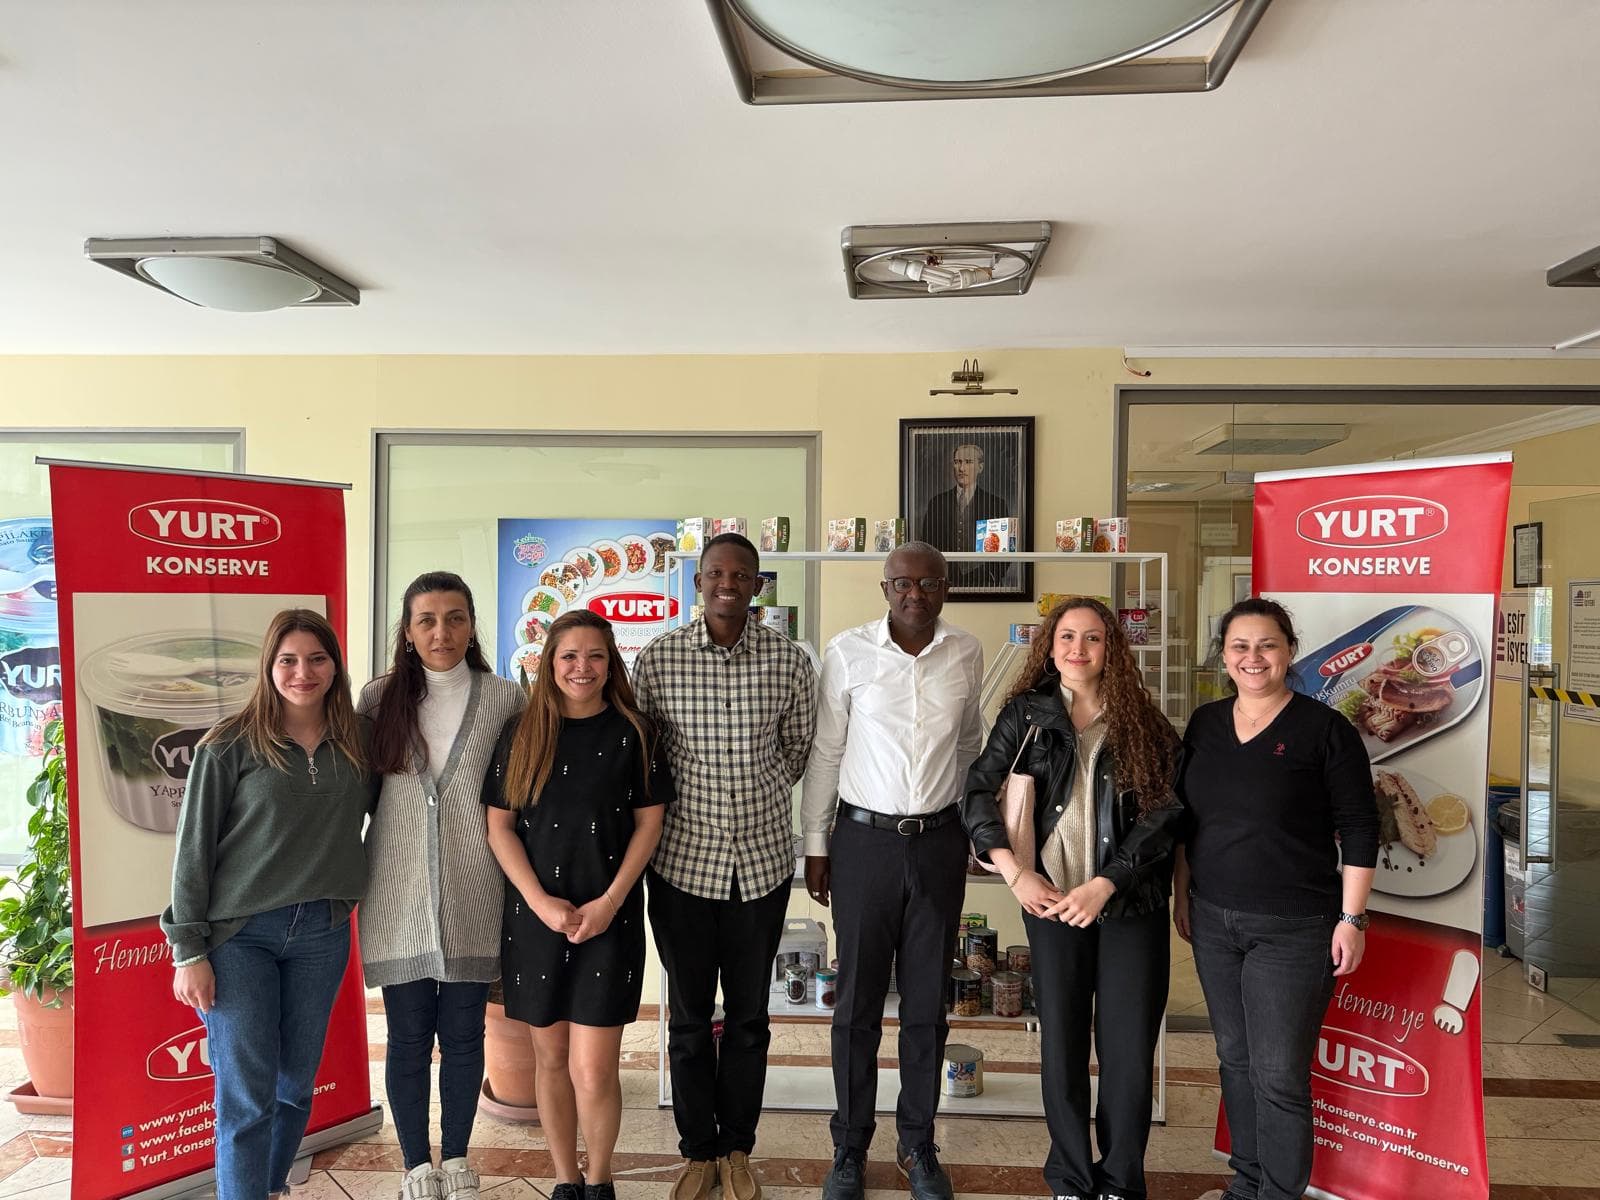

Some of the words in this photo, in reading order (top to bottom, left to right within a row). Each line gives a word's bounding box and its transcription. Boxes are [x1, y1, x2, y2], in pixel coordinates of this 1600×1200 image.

[148, 509, 260, 541] YURT
[1314, 507, 1425, 539] YURT
[147, 556, 269, 576] KONSERVE
[1308, 556, 1431, 576] KONSERVE
[601, 599, 667, 617] YURT
[1507, 610, 1526, 637] EŞİT
[1325, 646, 1366, 673] YURT
[94, 939, 170, 974] Hemen
[1393, 1008, 1424, 1043] ye
